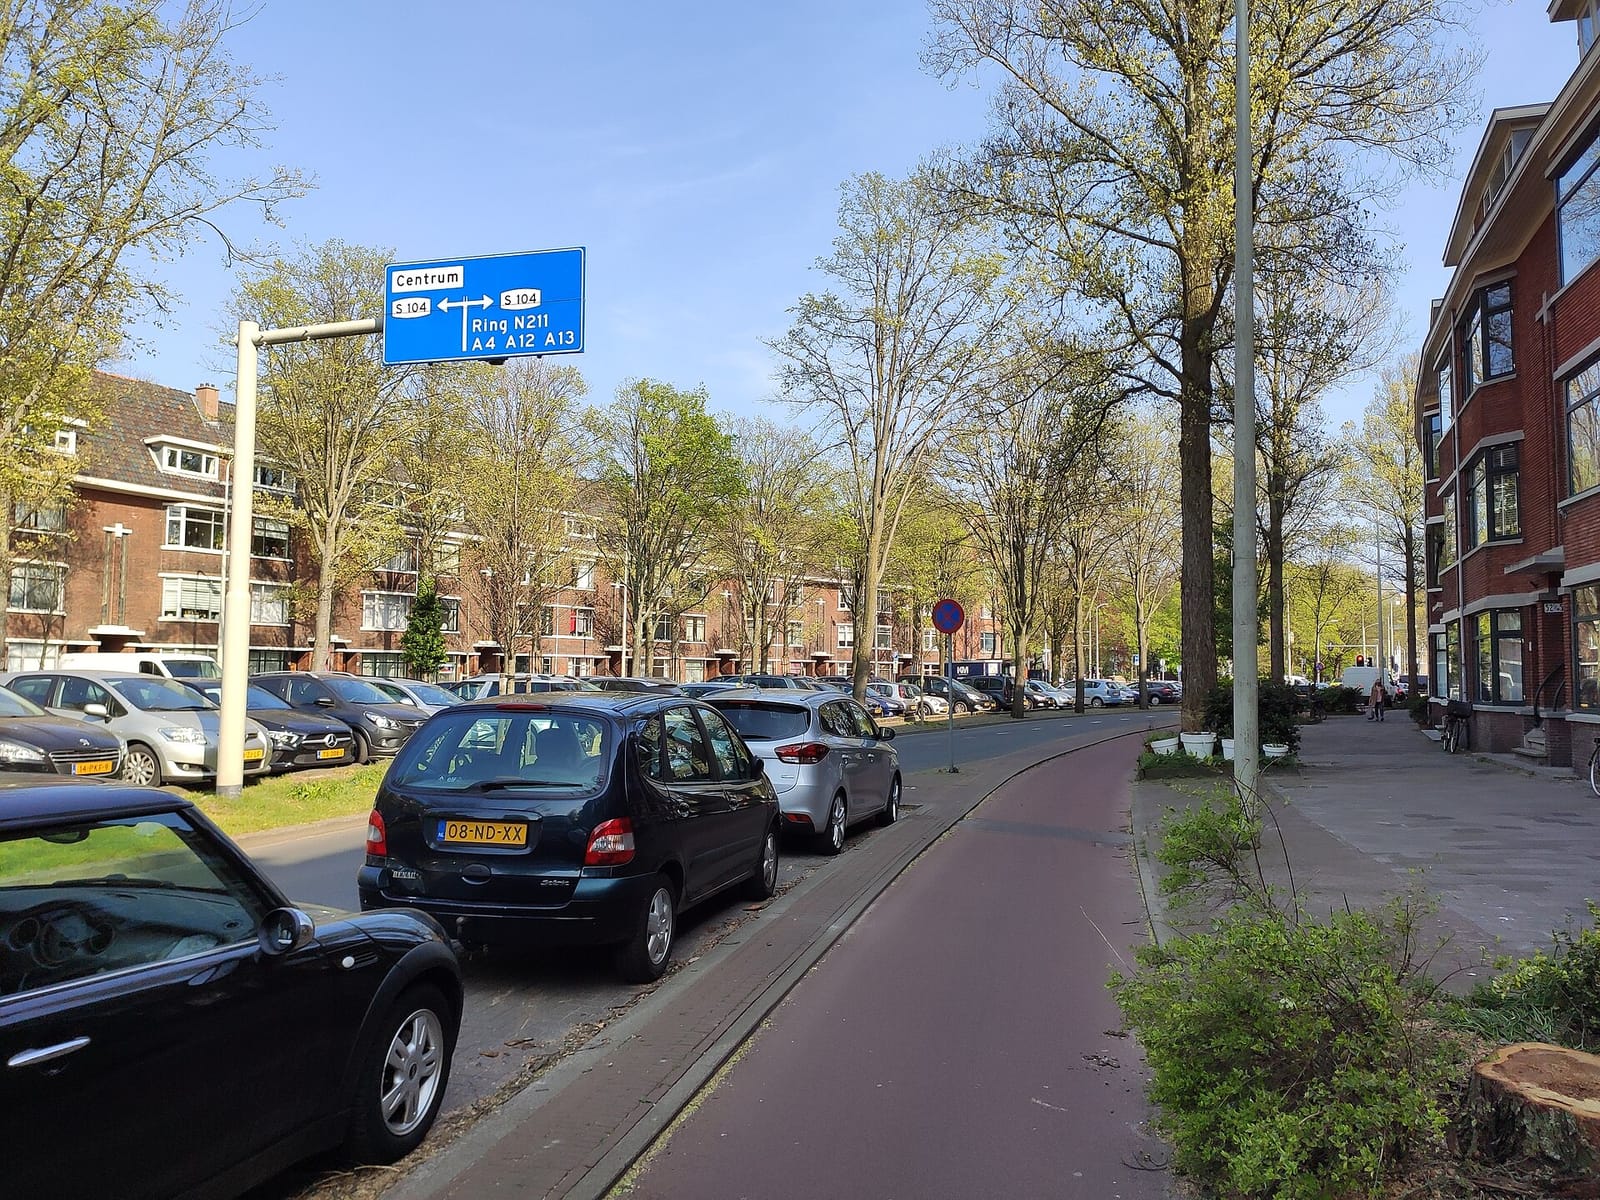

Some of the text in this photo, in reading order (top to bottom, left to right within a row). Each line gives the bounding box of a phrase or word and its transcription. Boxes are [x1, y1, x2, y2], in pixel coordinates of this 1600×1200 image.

[396, 271, 459, 287] Centrum
[504, 293, 537, 306] S 104
[396, 302, 427, 315] S 104
[472, 313, 549, 335] Ring N211
[472, 330, 575, 351] A4 A12 A13
[448, 823, 522, 841] 08-ND-XX
